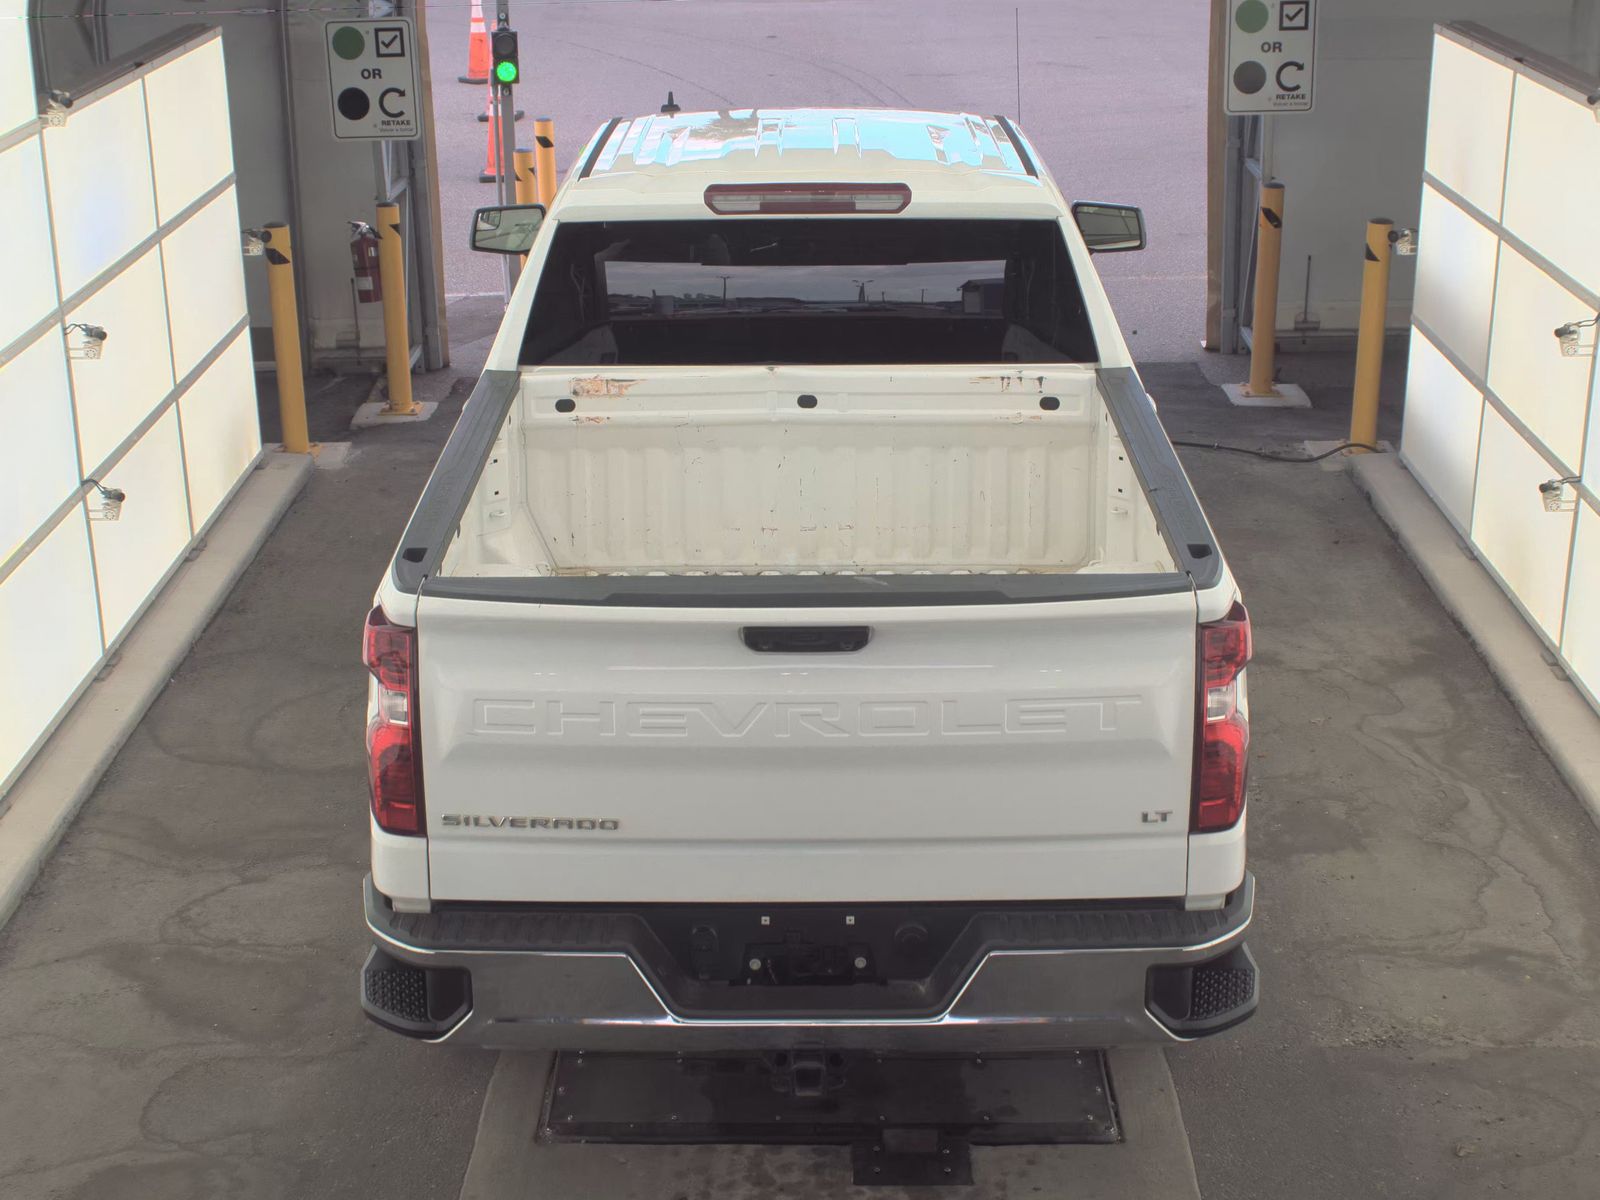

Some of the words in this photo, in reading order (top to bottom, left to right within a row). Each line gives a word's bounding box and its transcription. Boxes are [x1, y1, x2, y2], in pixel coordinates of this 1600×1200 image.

[1261, 41, 1283, 53] OR
[361, 68, 383, 80] OR
[472, 694, 1142, 737] CHEVROLET
[440, 813, 620, 831] SILVERADO
[1140, 810, 1174, 824] LT
